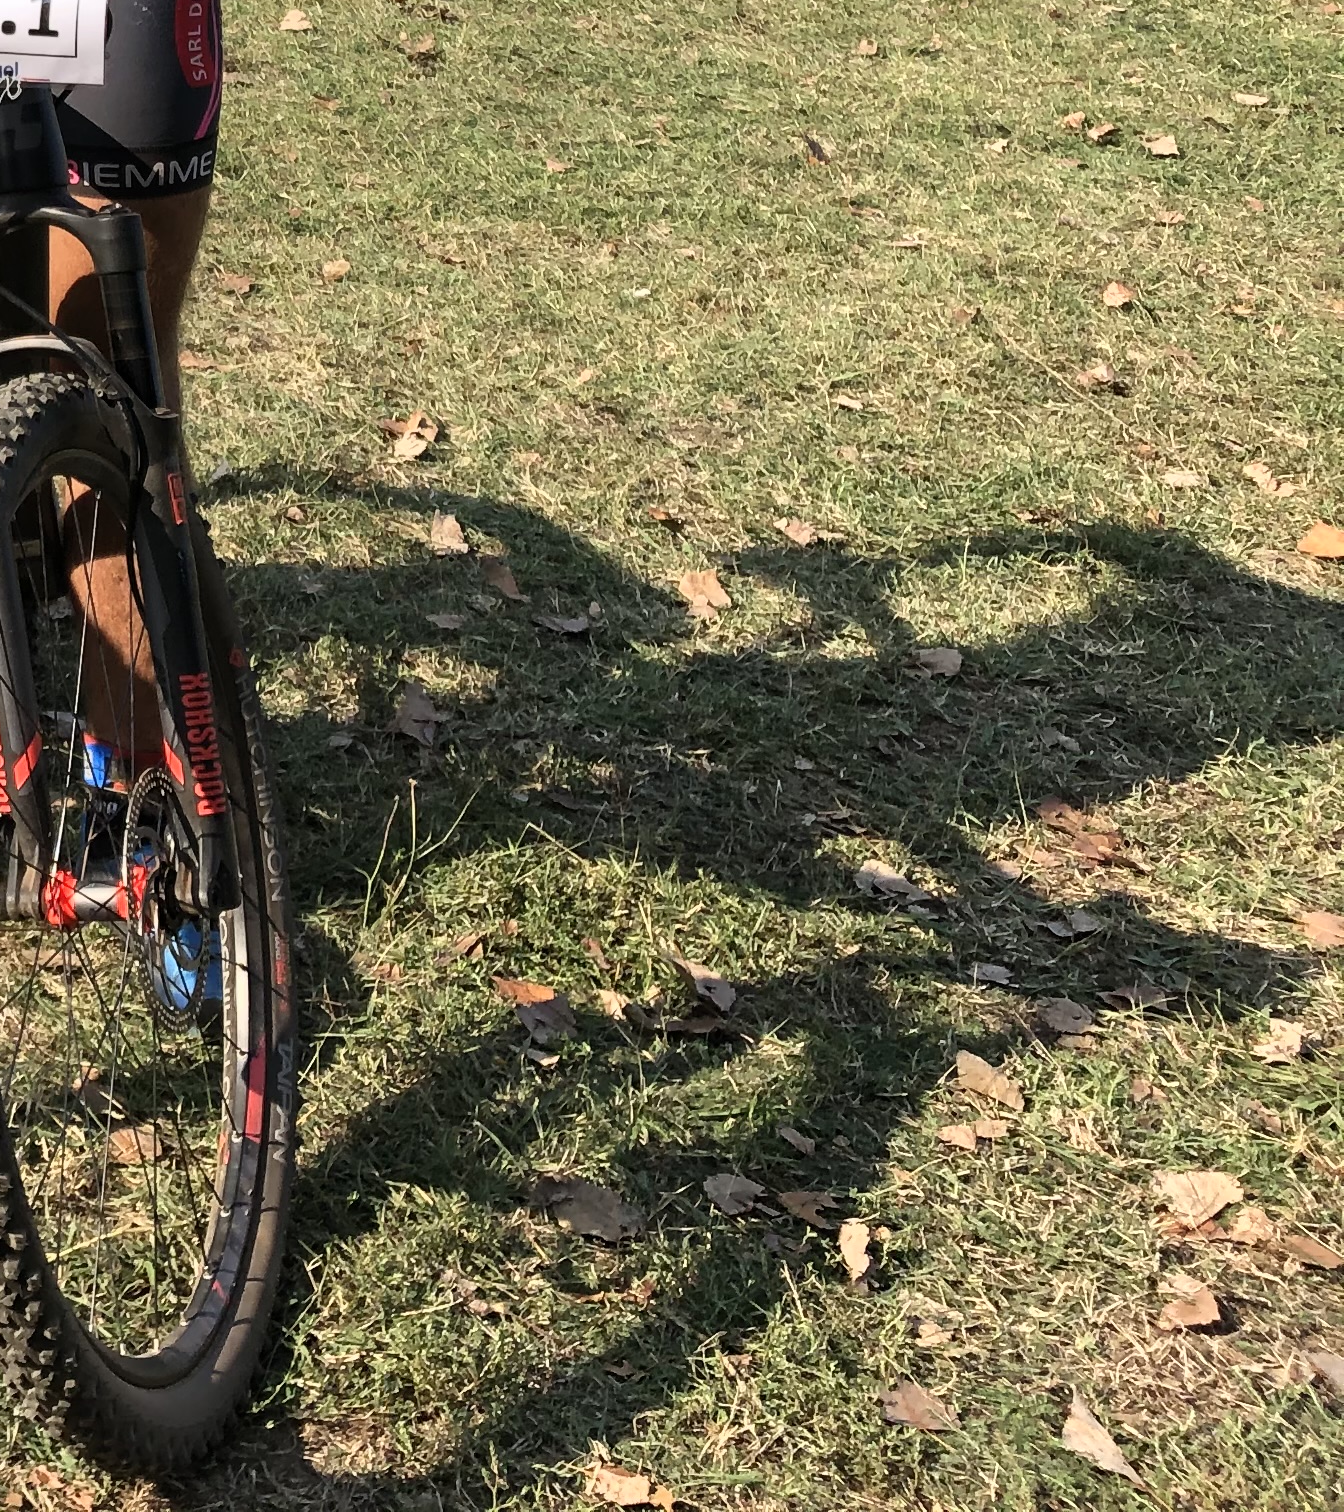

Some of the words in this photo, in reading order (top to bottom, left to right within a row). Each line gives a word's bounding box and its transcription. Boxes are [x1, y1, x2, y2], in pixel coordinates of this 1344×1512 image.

[187, 24, 207, 82] SARL
[178, 672, 226, 817] ROCKSHOX
[273, 1040, 296, 1164] TAIPAN
